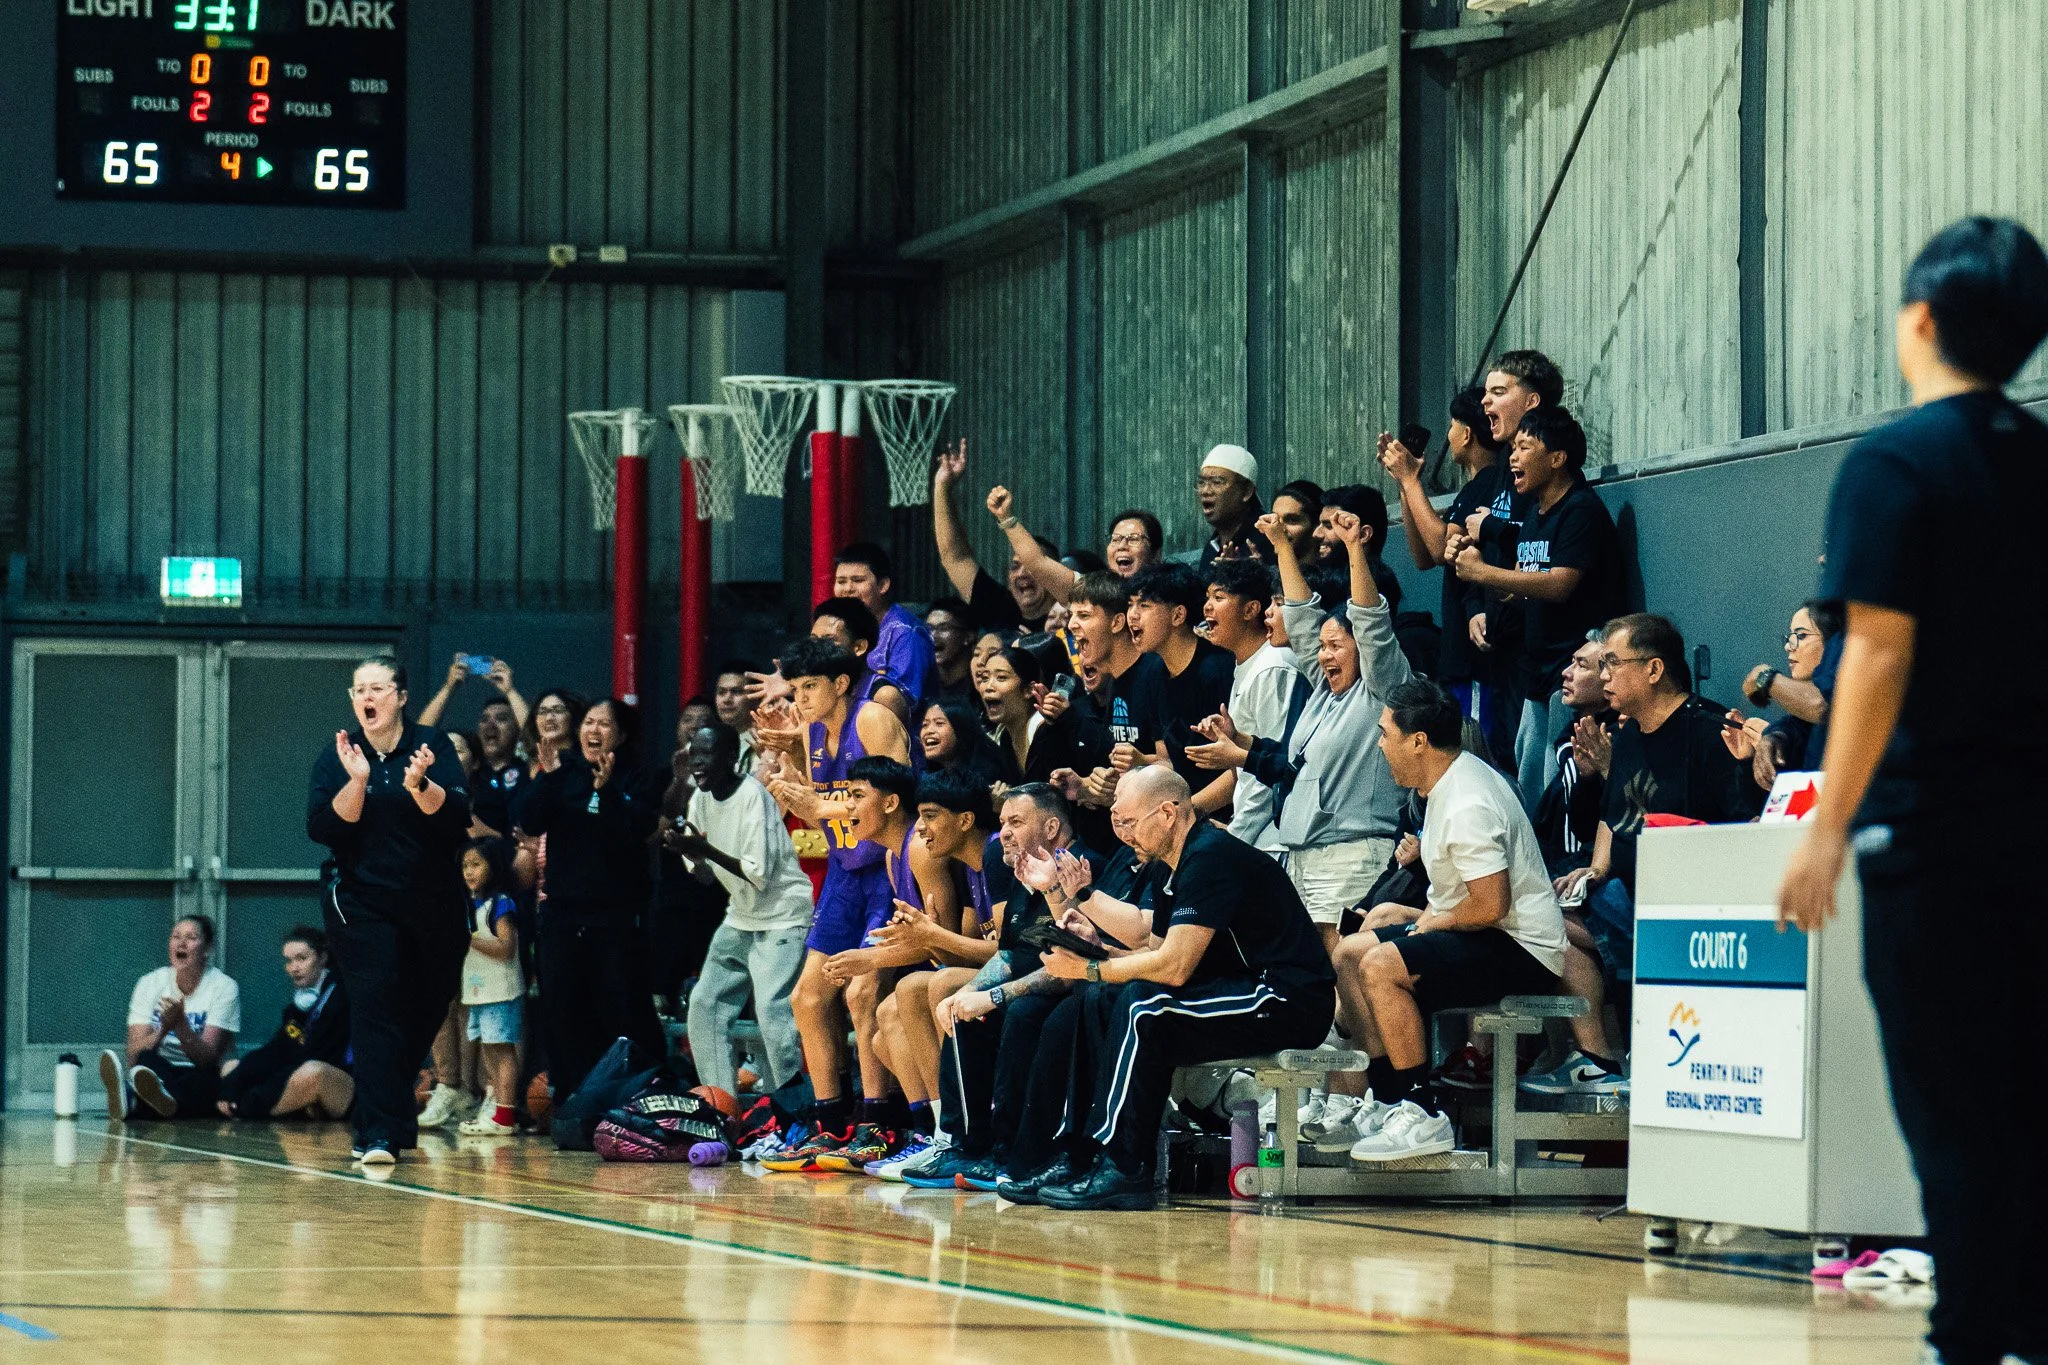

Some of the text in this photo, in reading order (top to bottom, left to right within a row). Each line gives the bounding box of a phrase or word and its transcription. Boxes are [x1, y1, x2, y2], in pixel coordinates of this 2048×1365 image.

[67, 0, 153, 18] LIGHT
[305, 0, 396, 29] DARK
[74, 67, 114, 83] SUBS
[190, 53, 212, 84] 0
[249, 56, 270, 86] 0
[350, 78, 389, 94] SUBS
[131, 90, 332, 124] FOULS 2 2 FOULS
[204, 132, 259, 148] PERIOD
[103, 141, 159, 185] 65
[221, 152, 241, 180] 4
[314, 148, 370, 191] 65
[1689, 931, 1748, 969] COURT 6
[1691, 1062, 1763, 1084] PENRITH VALLEY
[1666, 1091, 1762, 1115] REGIONAL SPORTS CENTRE
